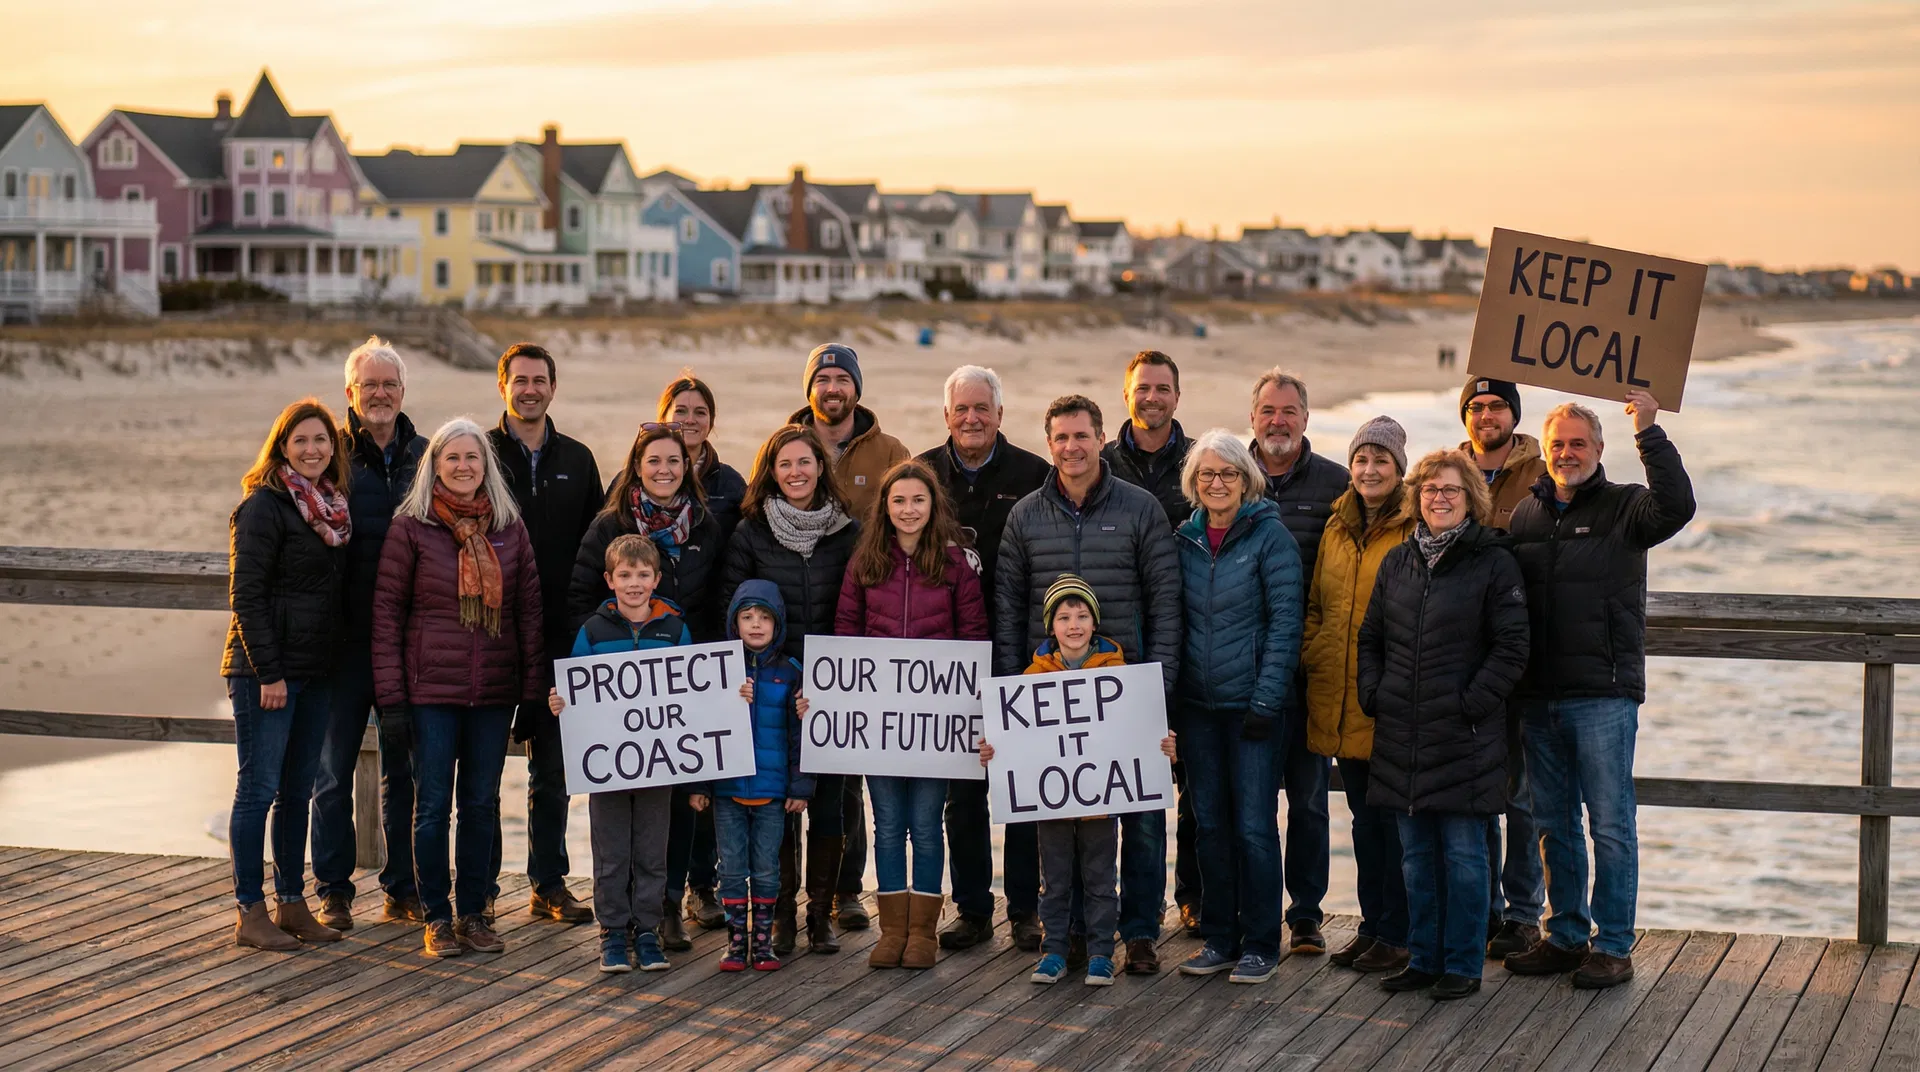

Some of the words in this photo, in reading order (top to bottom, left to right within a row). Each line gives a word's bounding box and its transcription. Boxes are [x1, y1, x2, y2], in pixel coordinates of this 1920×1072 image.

[1509, 247, 1612, 307] KEEP
[1628, 269, 1676, 321] IT
[1511, 314, 1651, 388] LOCAL
[567, 650, 734, 706] PROTECT
[812, 656, 878, 693] OUR
[889, 658, 981, 700] TOWN,
[999, 675, 1124, 731] KEEP
[623, 703, 687, 732] OUR
[809, 709, 870, 750] OUR
[881, 711, 984, 754] FUTURE
[1058, 731, 1090, 758] IT
[582, 729, 732, 784] COAST
[1007, 757, 1163, 813] LOCAL
